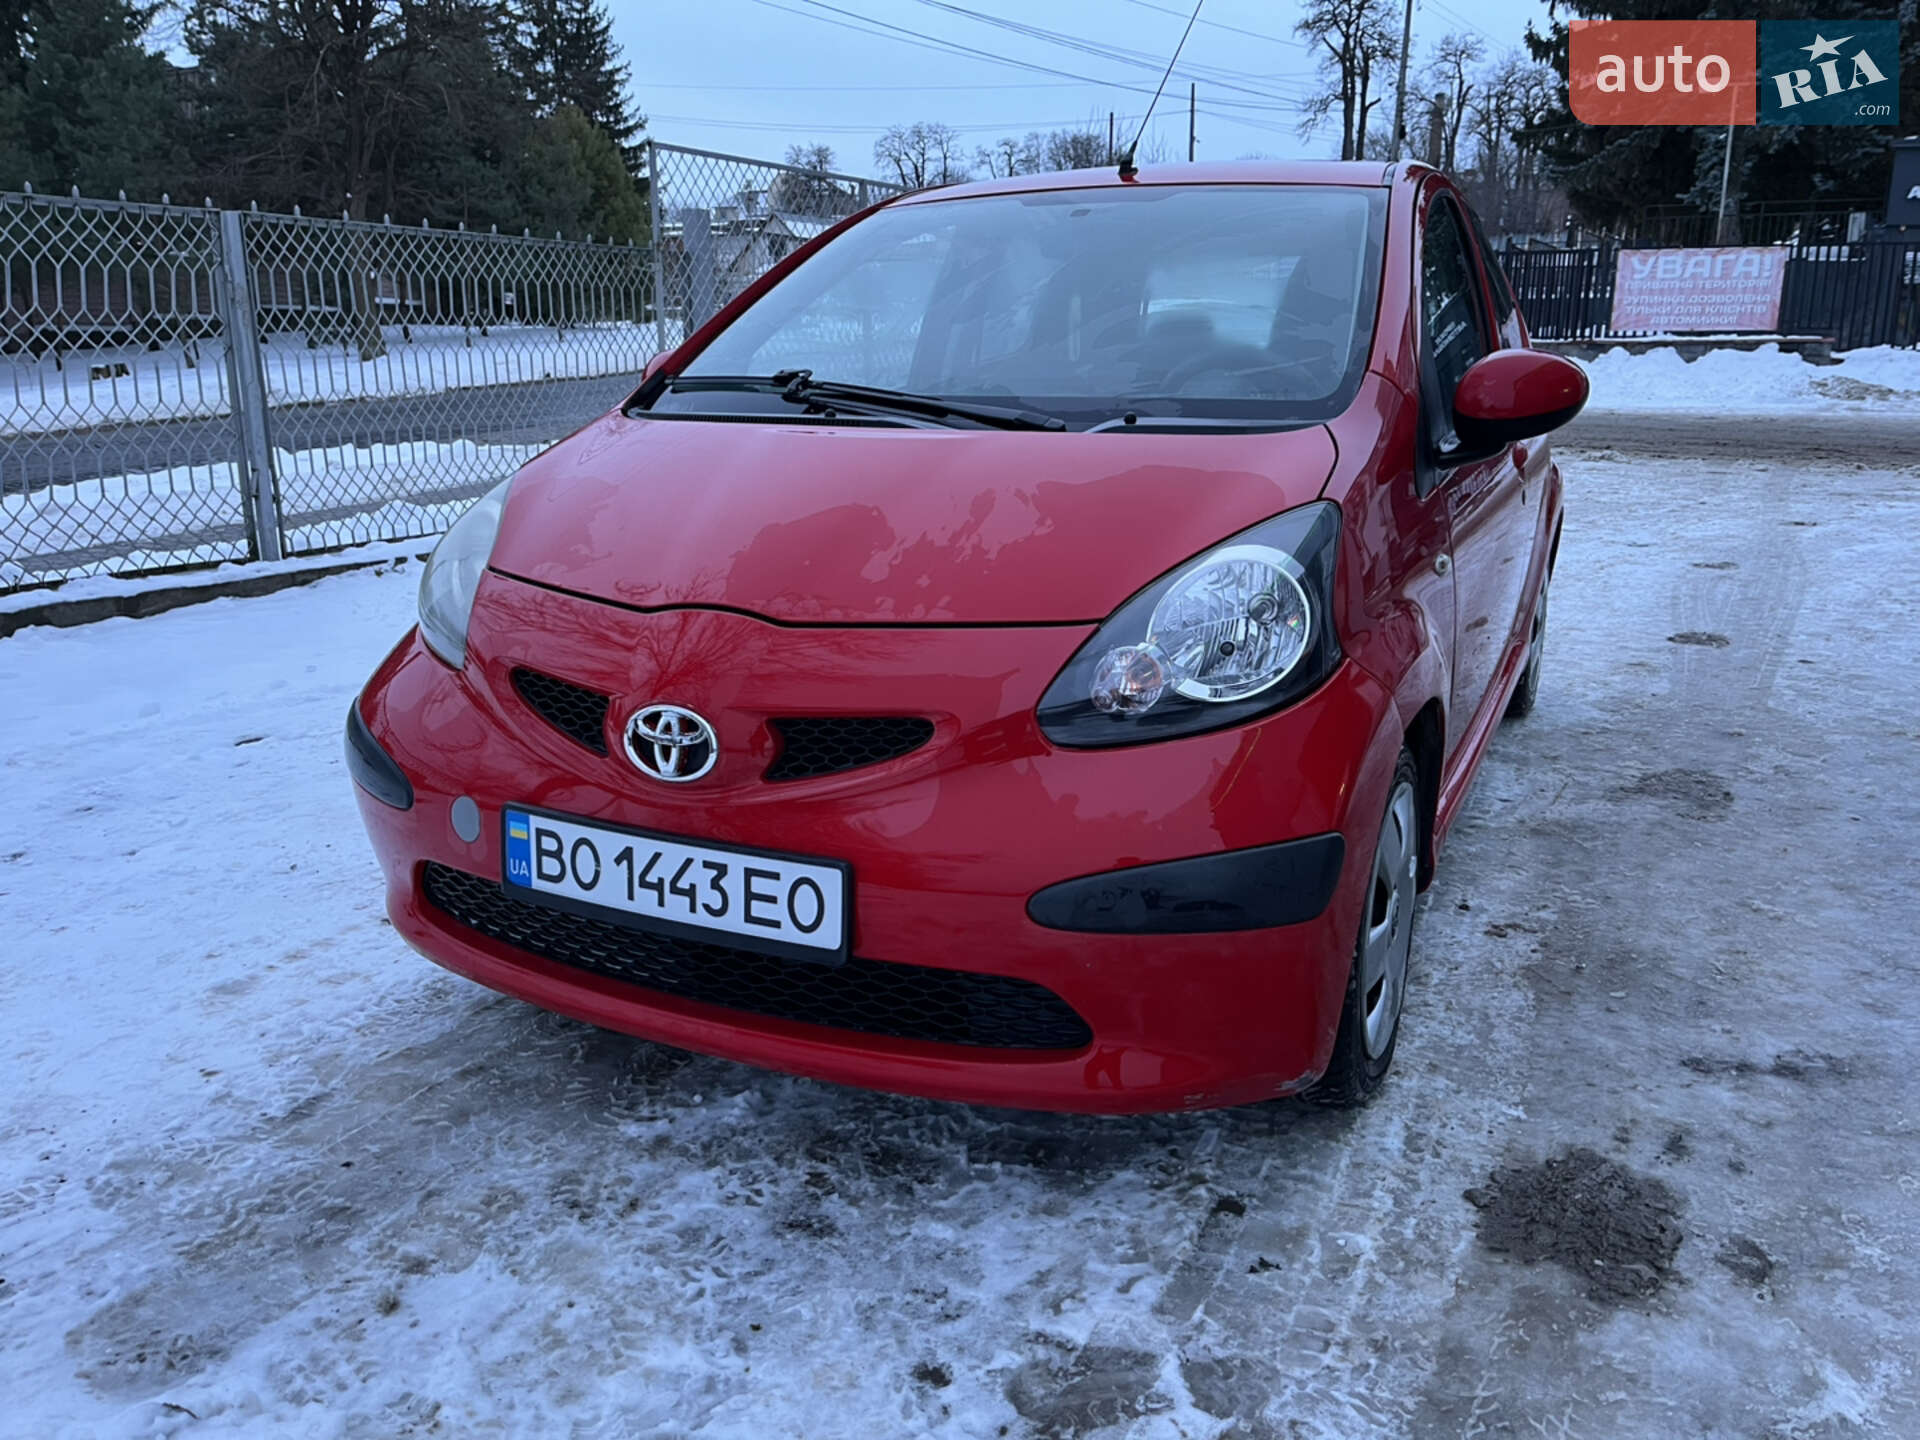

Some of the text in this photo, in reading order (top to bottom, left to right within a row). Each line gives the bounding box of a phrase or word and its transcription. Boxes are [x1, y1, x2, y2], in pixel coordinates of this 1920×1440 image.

[1630, 253, 1775, 280] УВАГА!
[509, 860, 530, 878] UA
[535, 827, 826, 934] BO 1443 EO
